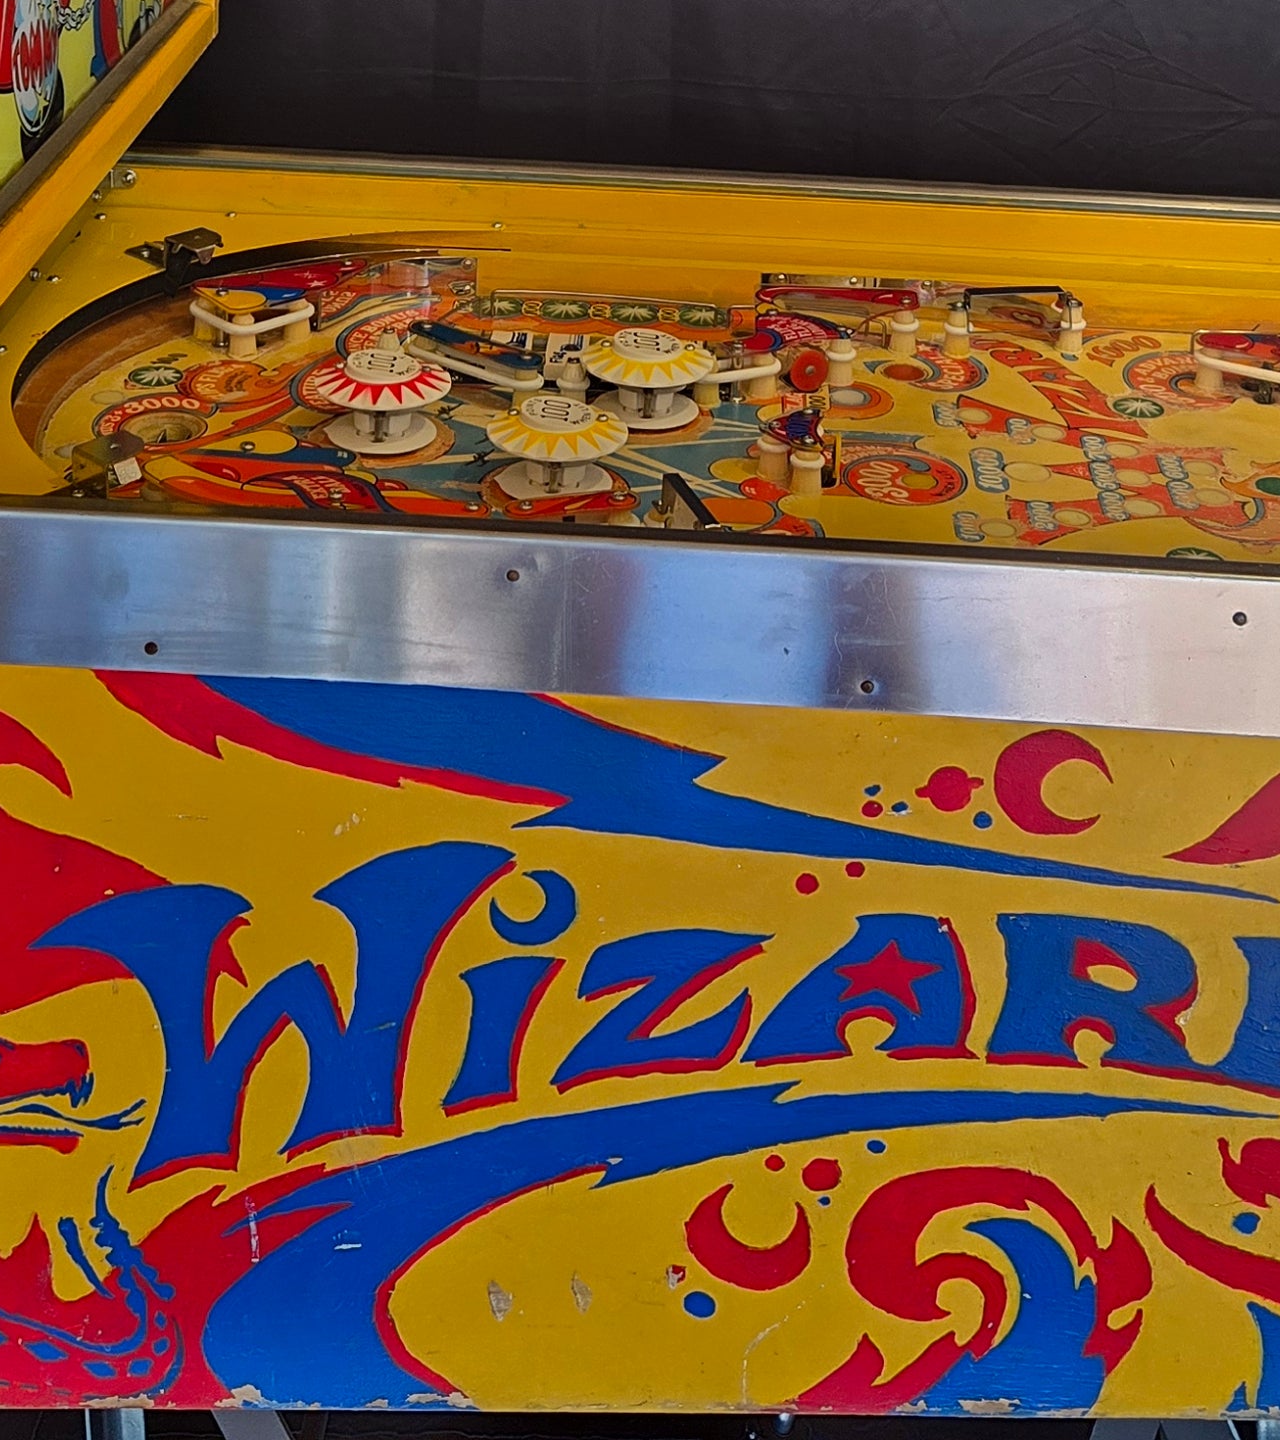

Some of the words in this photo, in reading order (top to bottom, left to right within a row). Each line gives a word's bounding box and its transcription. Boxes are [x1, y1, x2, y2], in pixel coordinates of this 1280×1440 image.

[123, 396, 201, 413] 3000
[541, 399, 571, 421] 100
[857, 461, 909, 498] 3000
[1093, 461, 1118, 490] 5000
[1031, 501, 1058, 531] 2000
